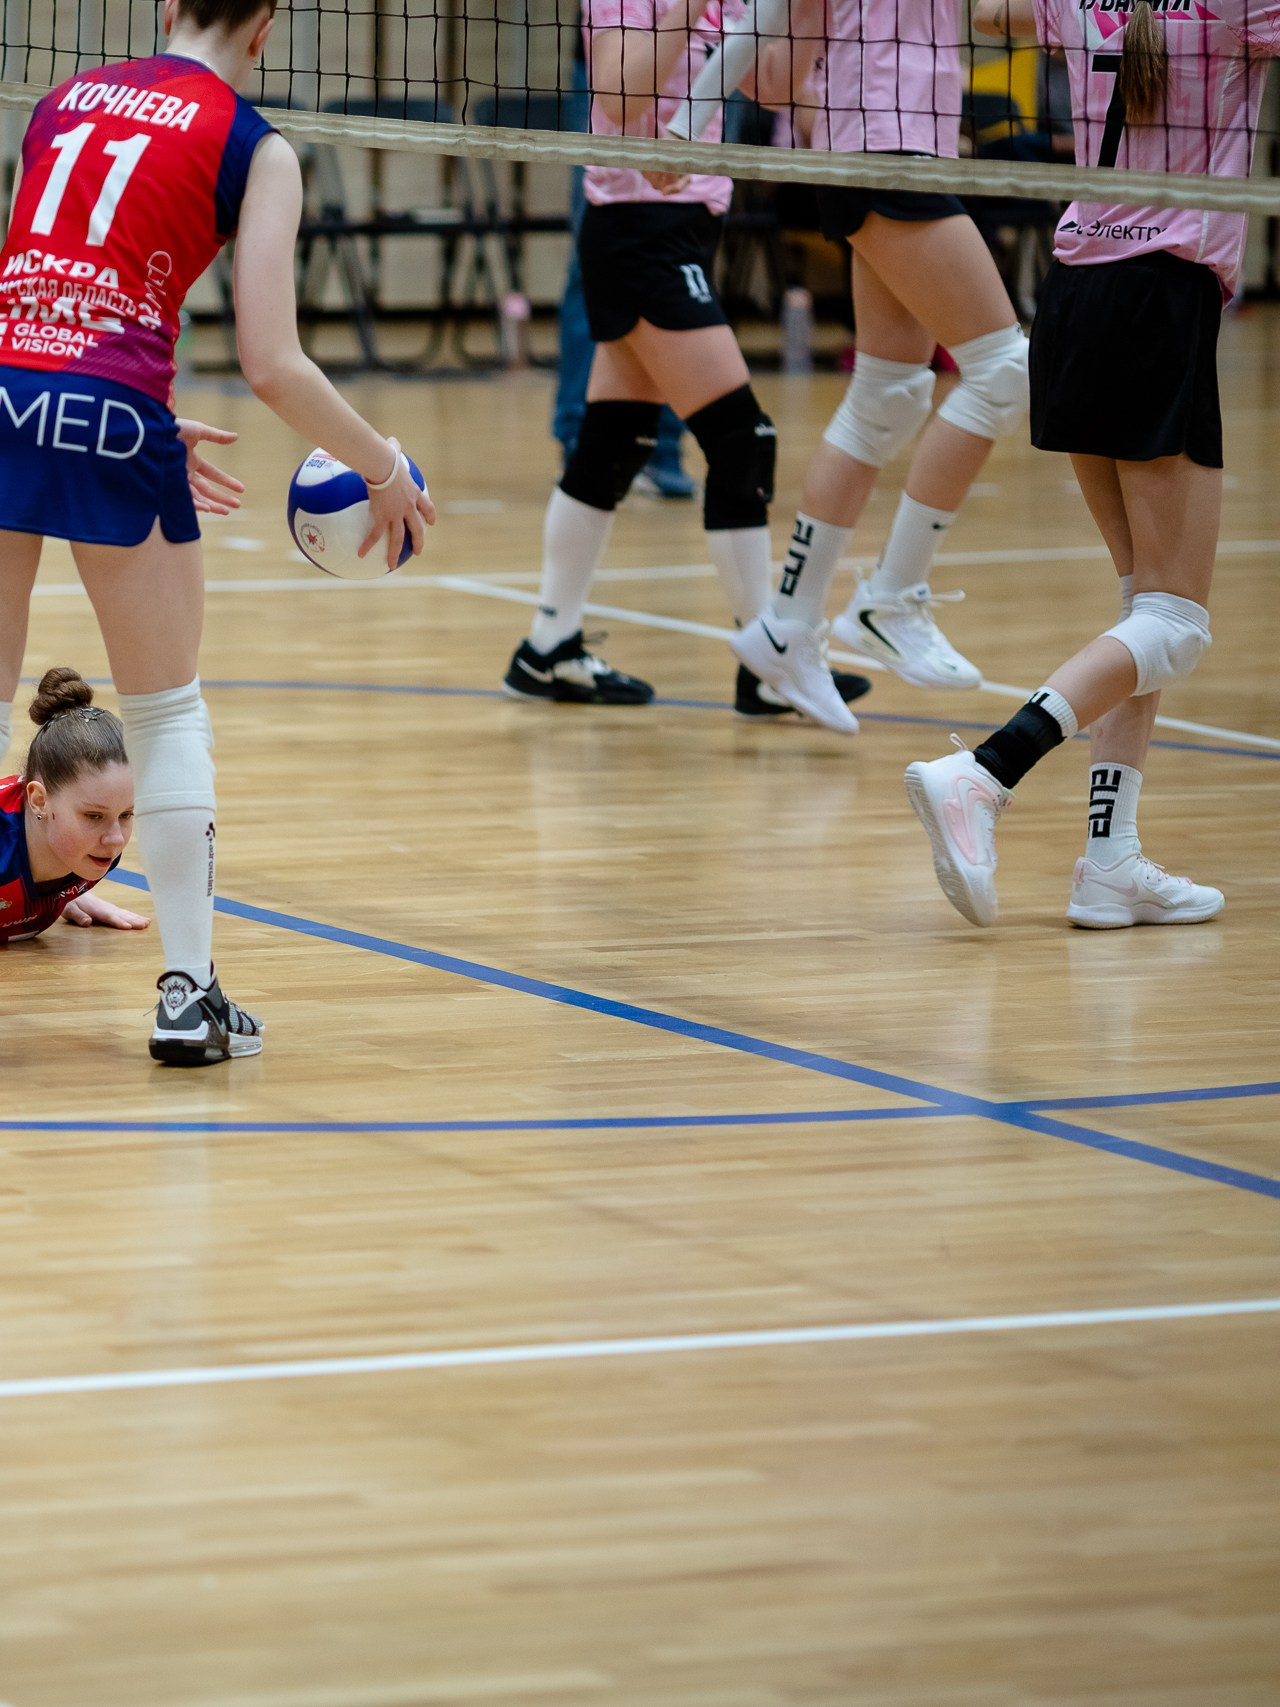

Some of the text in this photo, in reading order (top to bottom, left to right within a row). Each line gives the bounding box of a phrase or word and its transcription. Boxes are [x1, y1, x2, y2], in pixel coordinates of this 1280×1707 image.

[57, 81, 200, 132] КОЧНЕВА
[30, 122, 152, 247] 11
[1087, 220, 1168, 241] Электр
[3, 249, 120, 289] ИСКРА
[62, 281, 138, 316] ОБЛАСТЬ
[11, 337, 84, 359] VISION
[13, 323, 99, 347] GLOBAL
